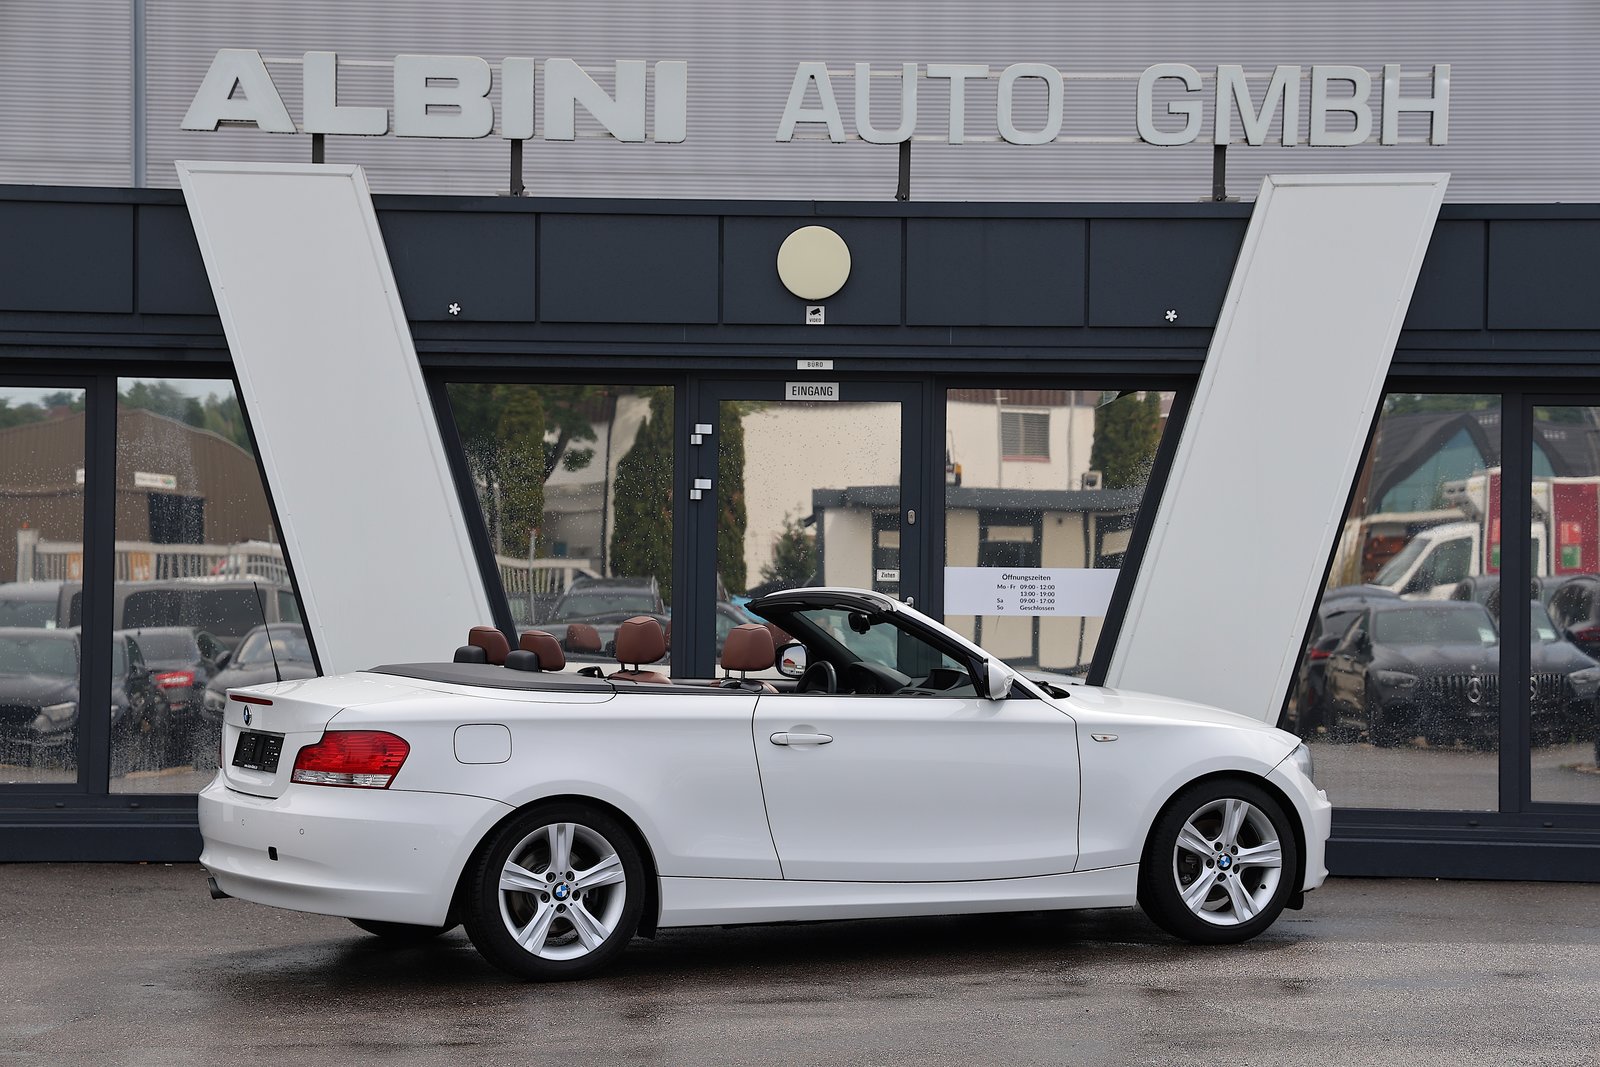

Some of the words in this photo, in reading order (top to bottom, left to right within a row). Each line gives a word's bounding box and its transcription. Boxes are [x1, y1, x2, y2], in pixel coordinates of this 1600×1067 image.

[181, 48, 687, 143] ALBINI
[776, 62, 1064, 146] AUTO
[1135, 63, 1450, 147] GMBH
[791, 385, 833, 396] EINGANG
[1002, 573, 1051, 581] Öffnungszeiten
